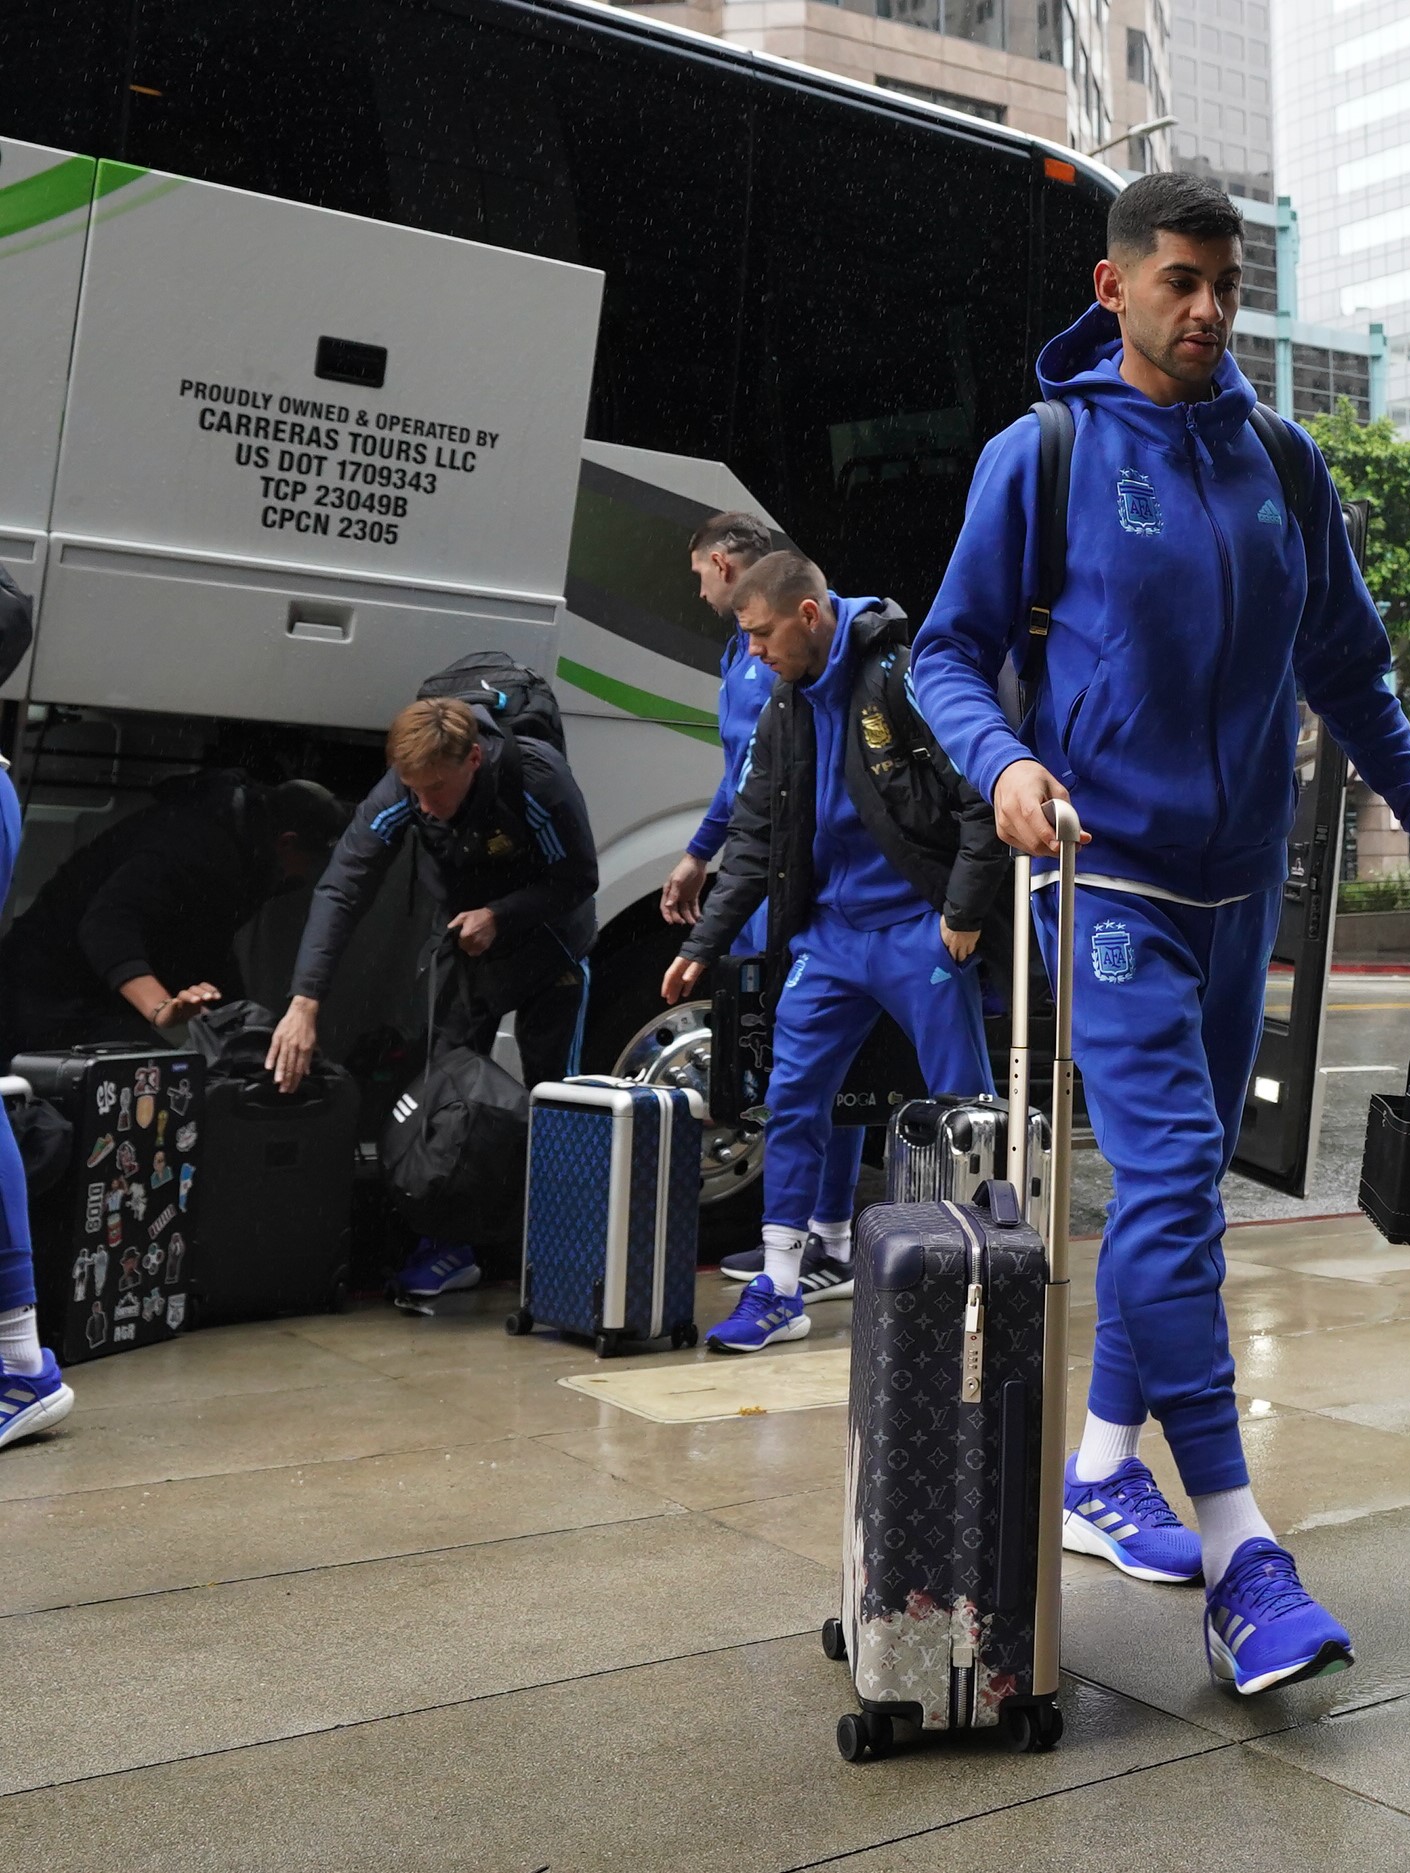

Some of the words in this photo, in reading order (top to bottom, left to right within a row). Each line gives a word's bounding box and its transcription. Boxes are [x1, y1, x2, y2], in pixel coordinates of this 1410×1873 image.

[179, 379, 273, 410] PROUDLY
[278, 396, 349, 424] OWNED
[355, 410, 369, 427] &
[376, 413, 471, 444] OPERATED
[476, 430, 499, 449] BY
[199, 407, 339, 451] CARRERAS
[348, 432, 427, 465] TOURS
[435, 447, 478, 473] LLC
[235, 442, 270, 469] US
[278, 452, 328, 477] DOT
[337, 459, 438, 495] 1709343
[260, 476, 307, 503] TCP
[314, 485, 408, 518] 23049B
[1130, 495, 1153, 519] AFA
[261, 505, 331, 536] CPCN
[338, 517, 399, 545] 2305
[1104, 946, 1126, 968] AFA
